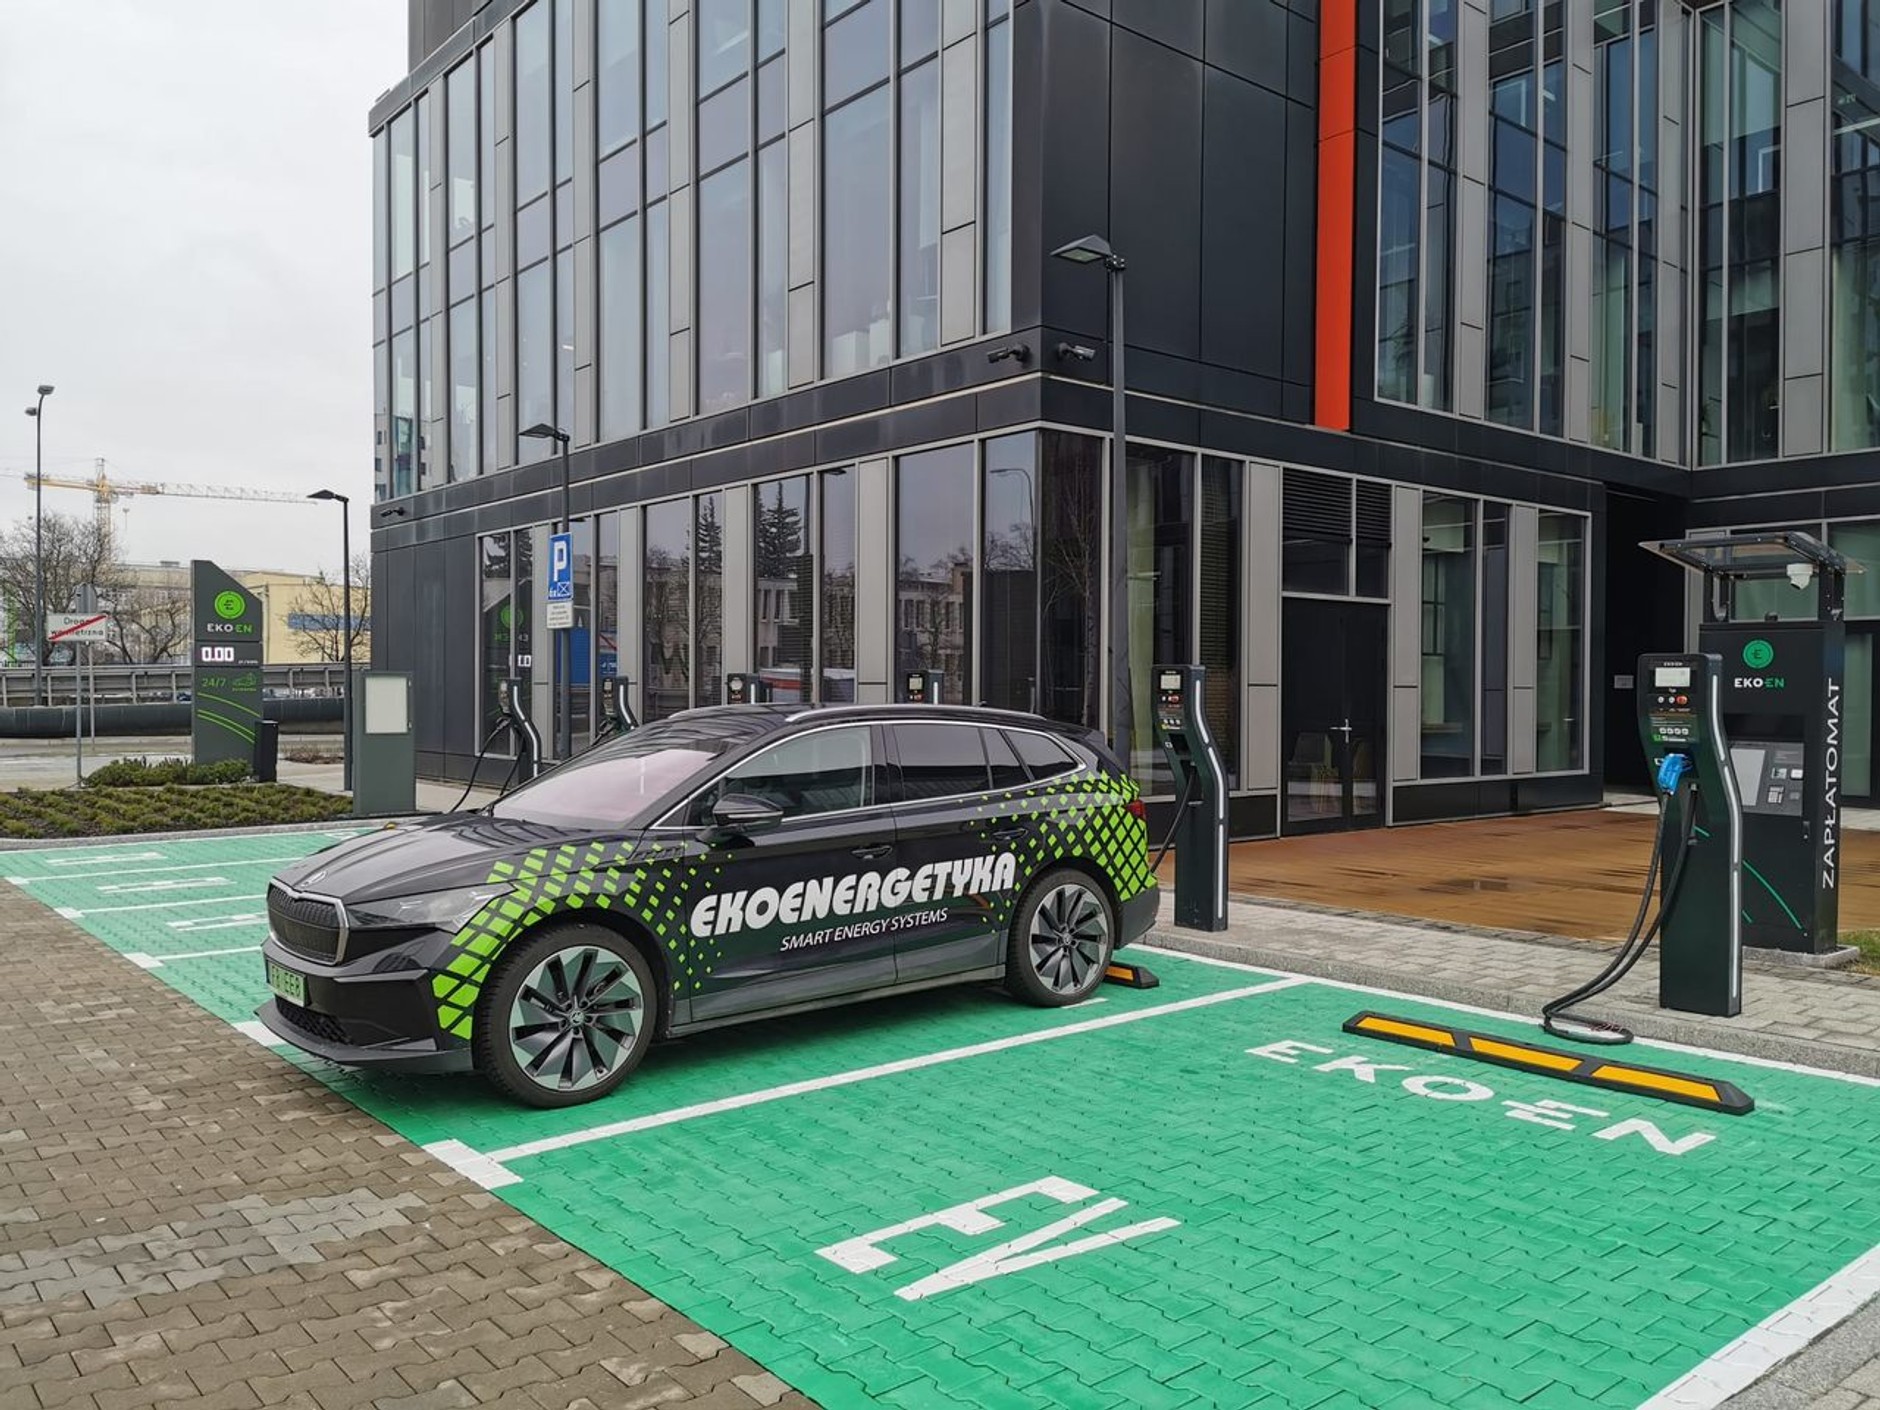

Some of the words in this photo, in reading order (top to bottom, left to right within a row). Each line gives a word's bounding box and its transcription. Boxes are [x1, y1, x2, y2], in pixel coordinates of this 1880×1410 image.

[552, 541, 567, 582] P
[206, 623, 253, 633] EKOEN
[201, 646, 235, 662] 0.00
[202, 678, 226, 688] 24/7
[1734, 678, 1785, 688] EKOEN
[1822, 677, 1841, 889] ZAPŁATOMAT
[690, 851, 1017, 938] EKOENERGETYKA
[779, 928, 835, 952] SMART
[834, 917, 891, 942] ENERGY
[890, 907, 949, 931] SYSTEMS
[813, 1175, 1183, 1301] EV
